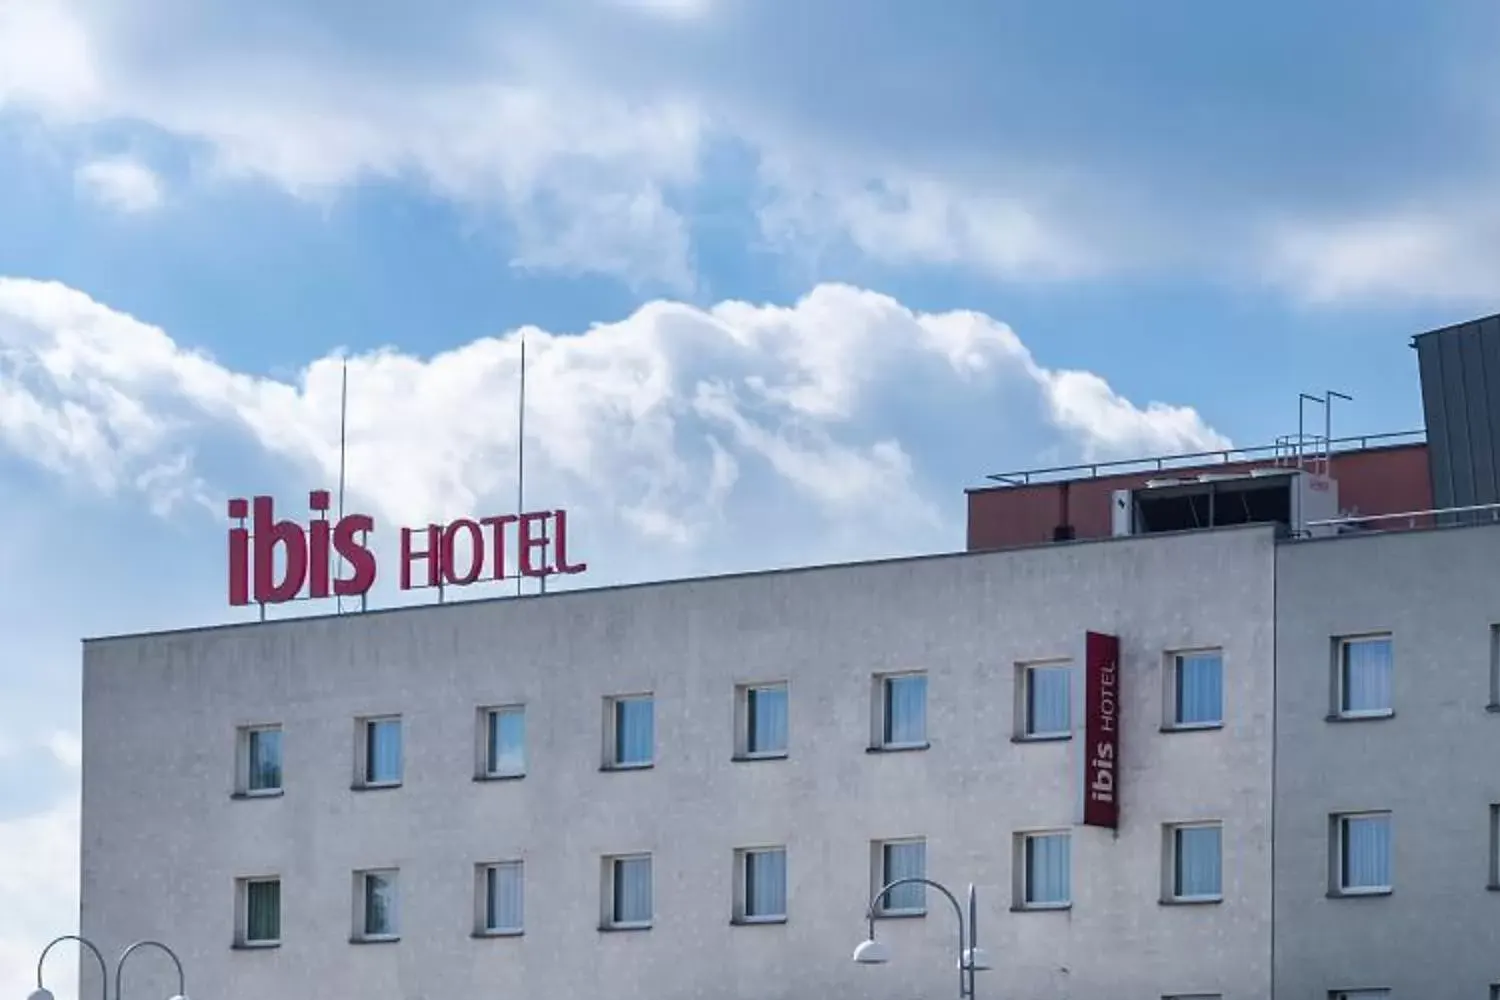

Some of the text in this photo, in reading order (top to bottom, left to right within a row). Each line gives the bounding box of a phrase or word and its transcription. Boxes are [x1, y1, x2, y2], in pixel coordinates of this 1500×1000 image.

[228, 490, 587, 606] ibis HOTEL
[1091, 660, 1116, 802] ibis HOTEL
